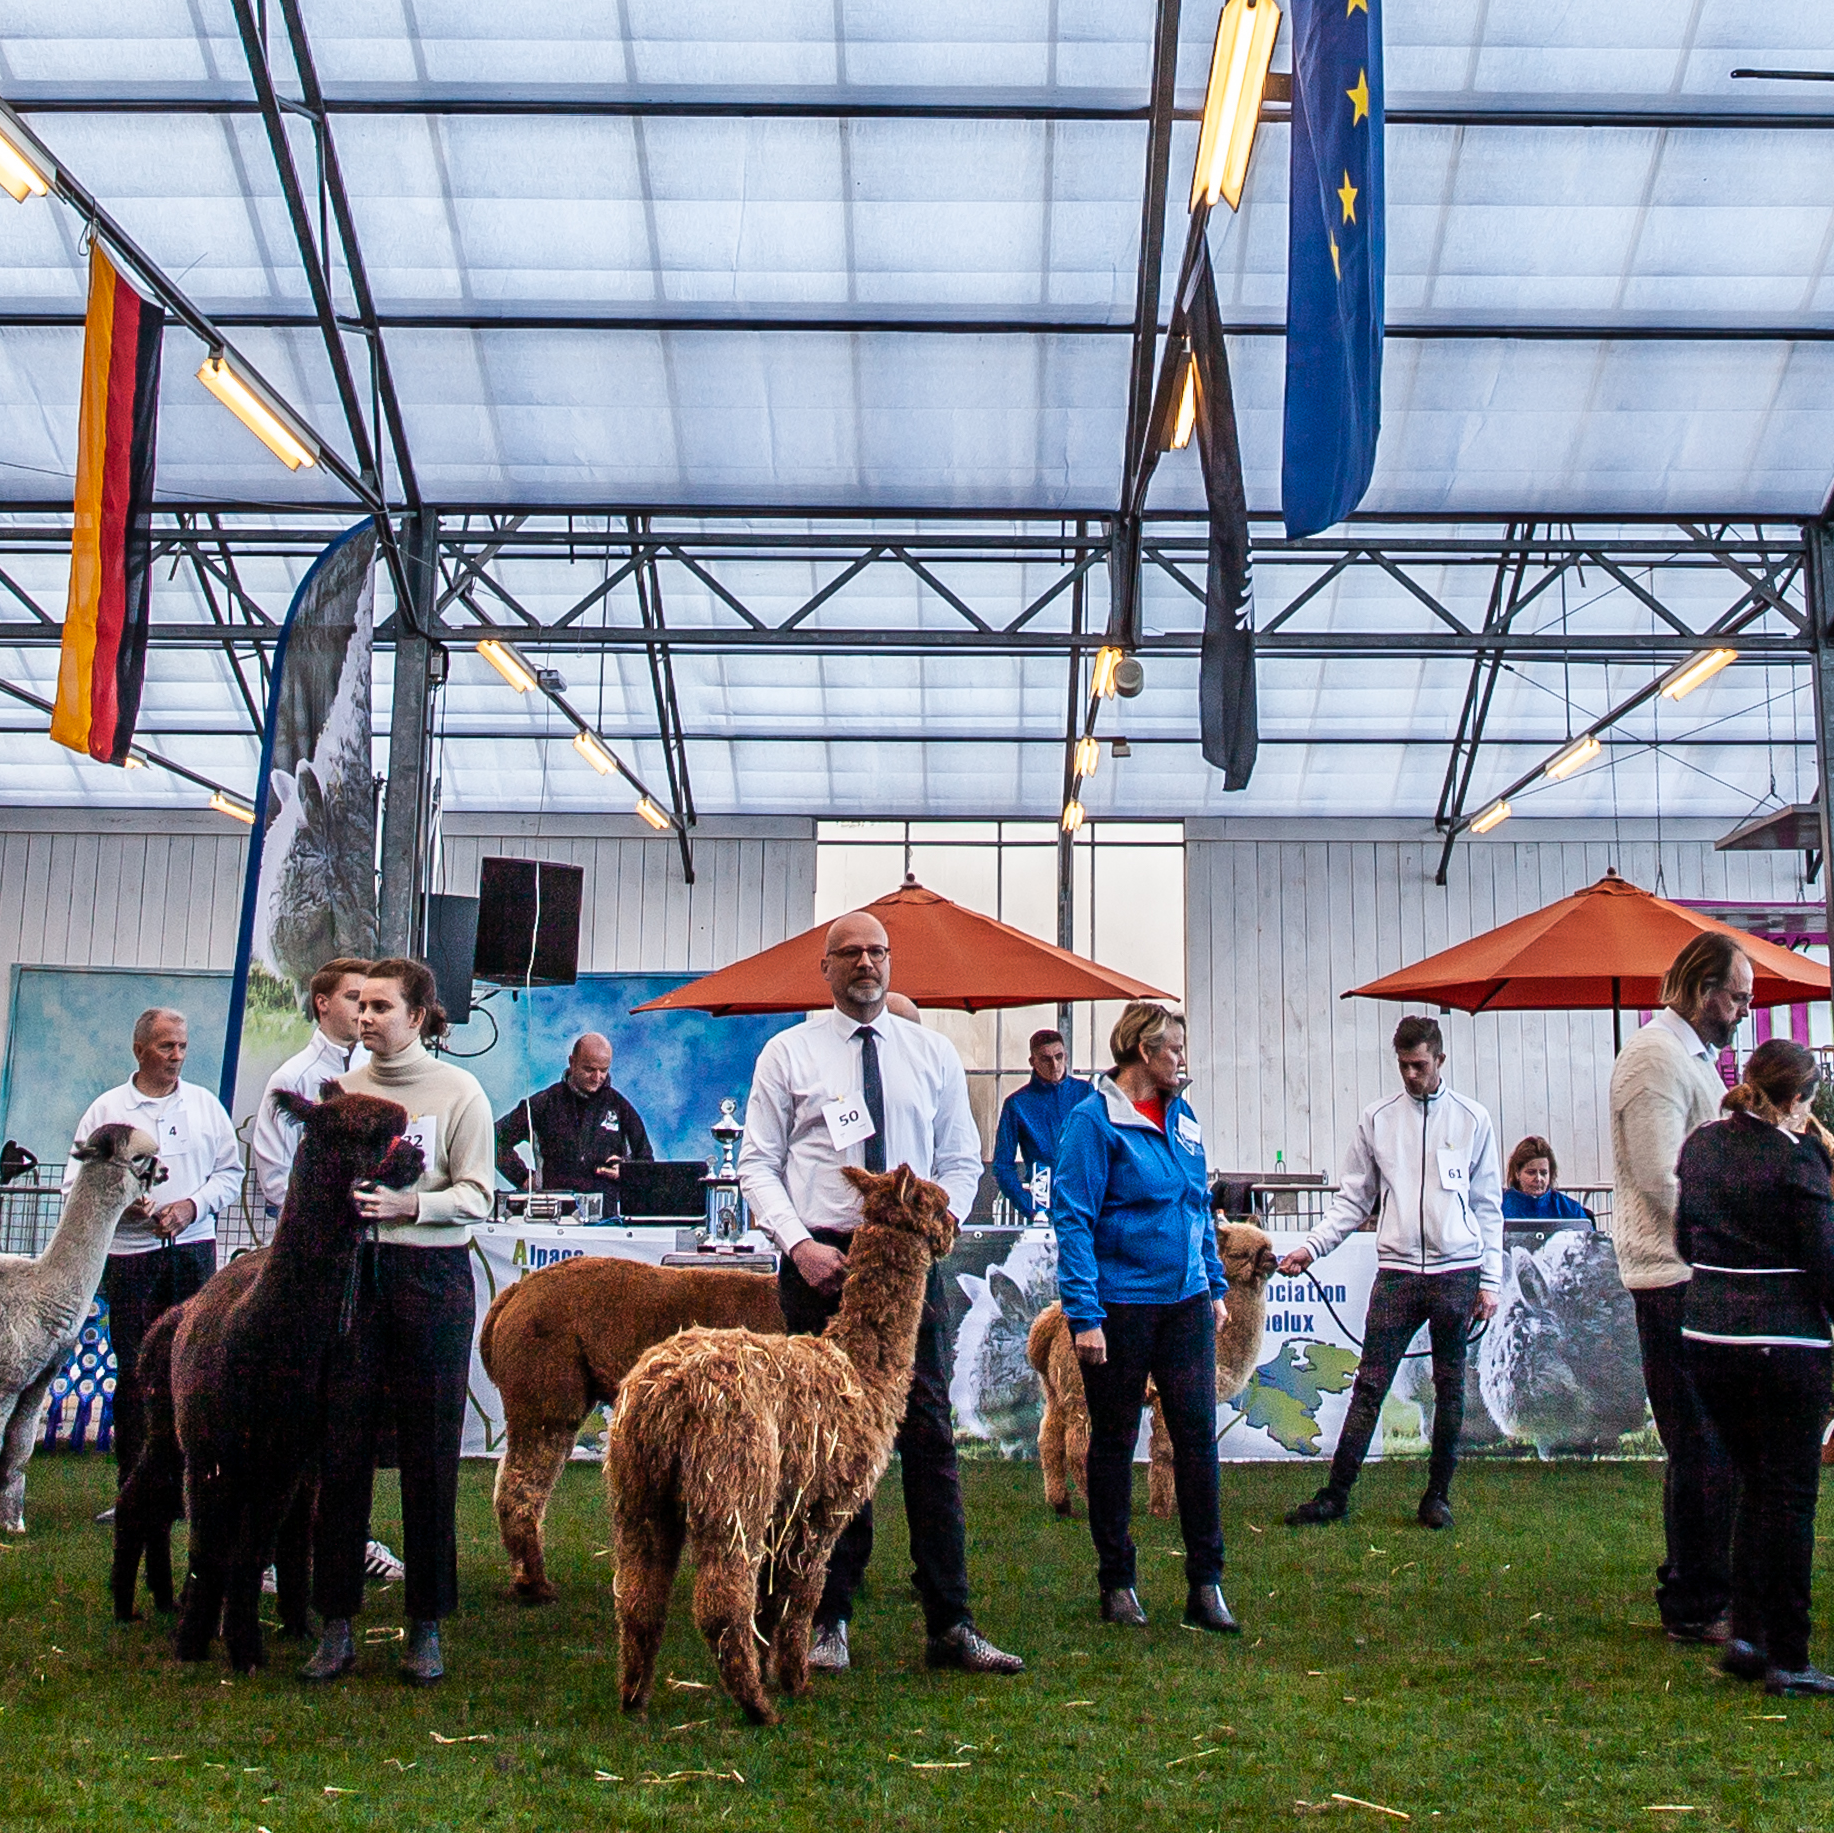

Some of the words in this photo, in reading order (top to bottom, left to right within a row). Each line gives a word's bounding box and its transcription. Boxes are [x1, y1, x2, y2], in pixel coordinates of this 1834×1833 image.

[838, 1109, 859, 1127] 50
[169, 1125, 177, 1136] 4
[1448, 1168, 1462, 1179] 61
